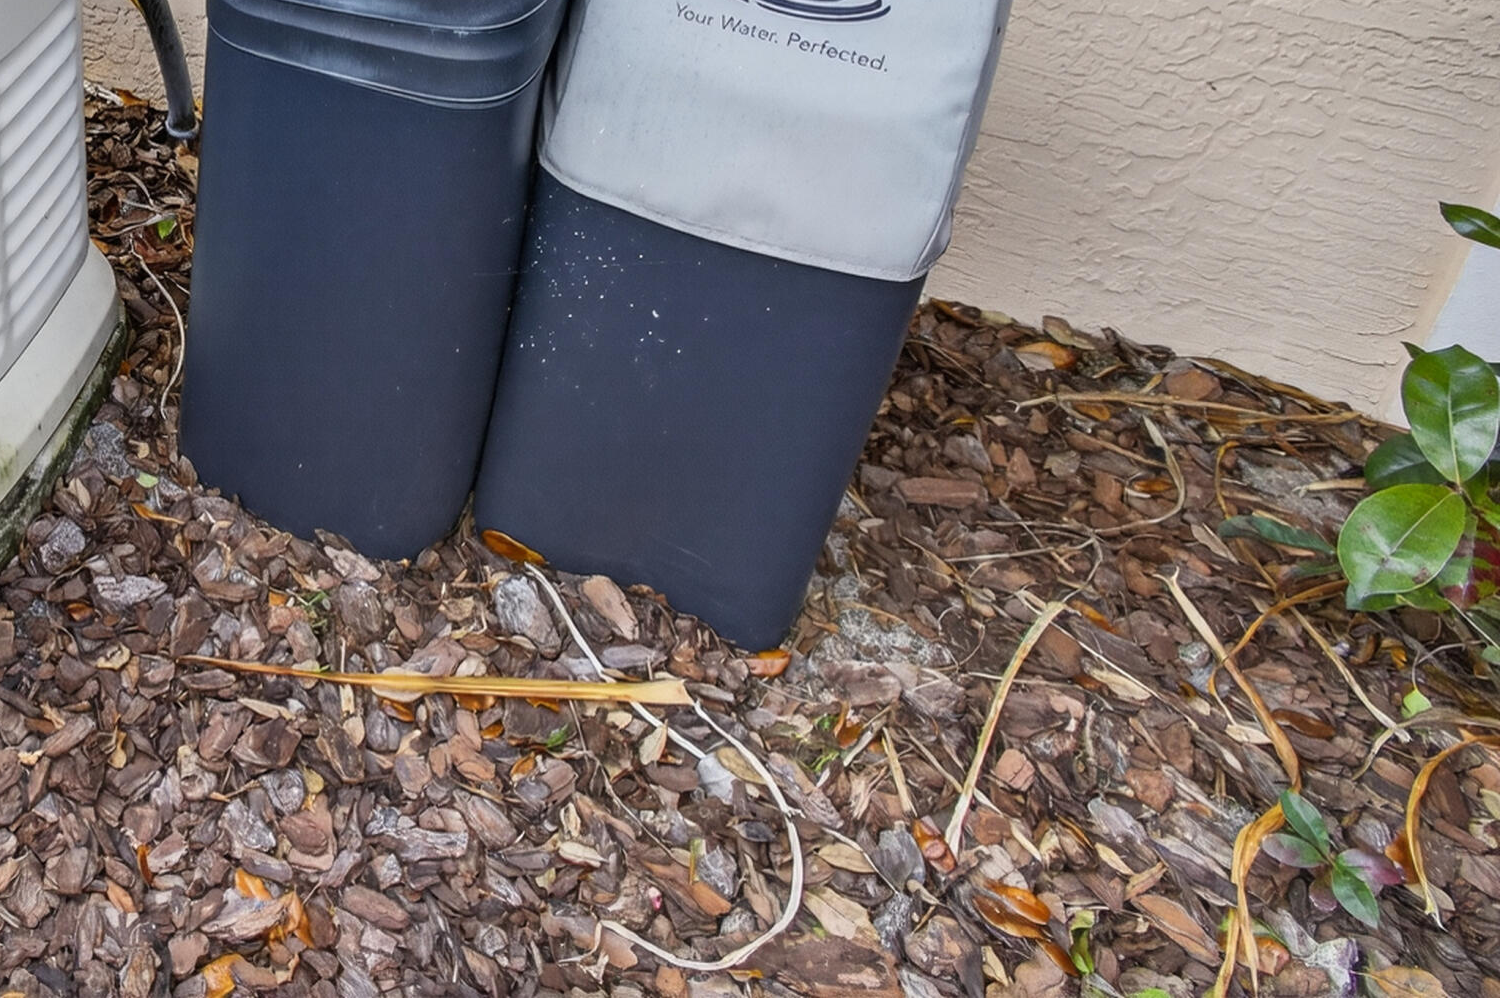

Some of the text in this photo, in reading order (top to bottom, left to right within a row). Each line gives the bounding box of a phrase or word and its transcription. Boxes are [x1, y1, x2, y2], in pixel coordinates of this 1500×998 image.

[675, 2, 889, 72] Your Water. Perfected.
